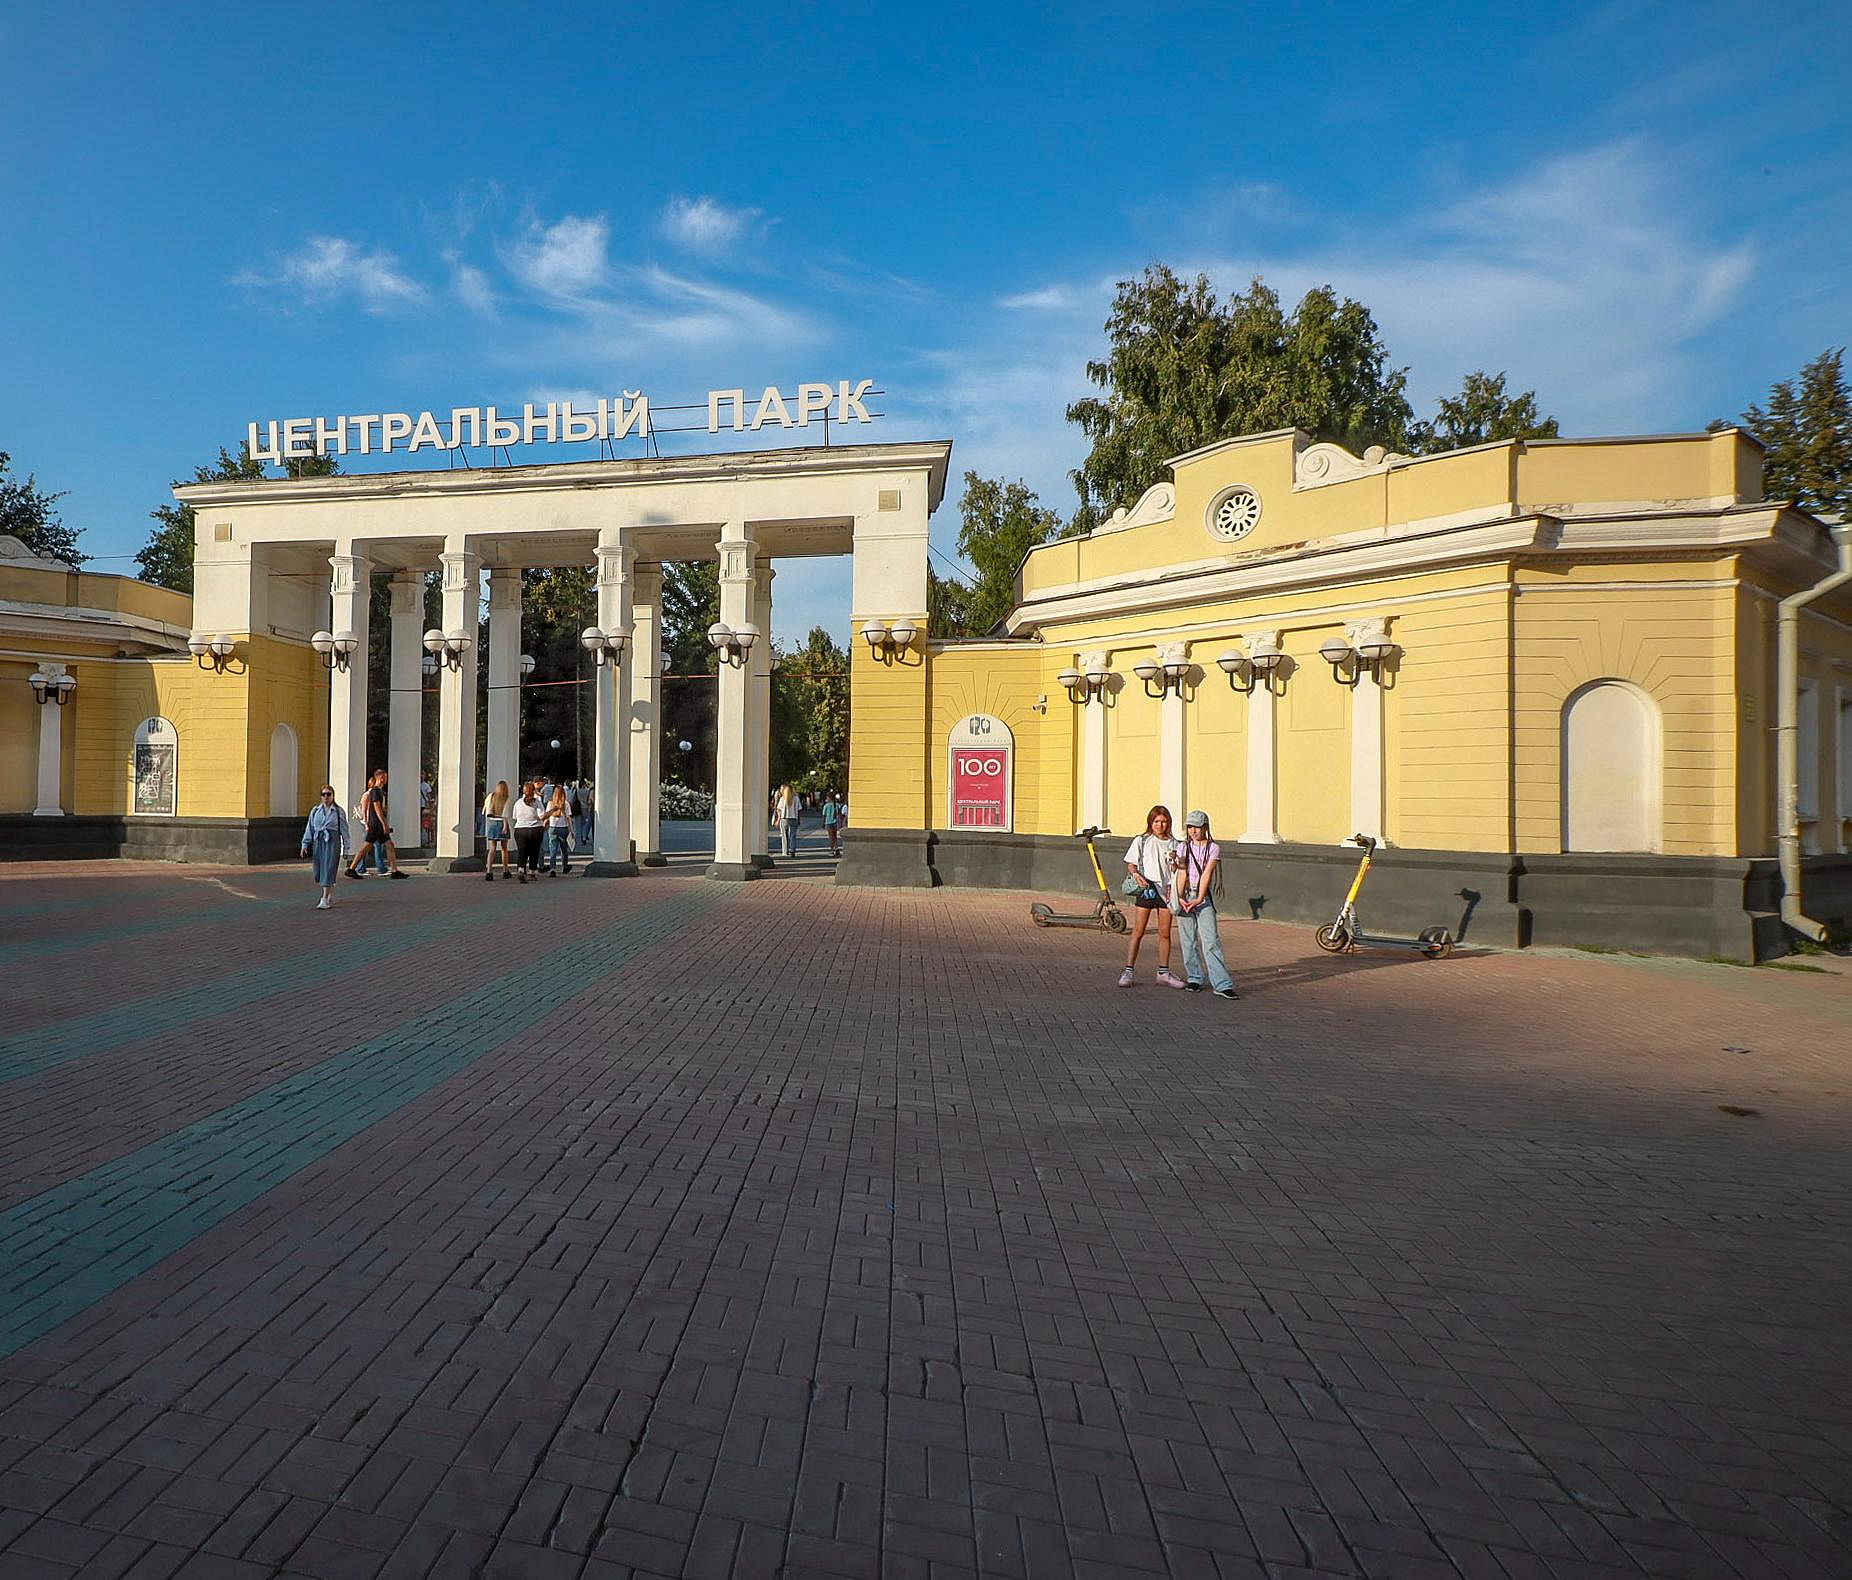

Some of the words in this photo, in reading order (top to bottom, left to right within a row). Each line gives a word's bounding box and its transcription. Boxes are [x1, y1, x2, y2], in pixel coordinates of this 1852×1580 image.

[248, 389, 650, 466] ЦЕНТРАЛЬНЫЙ
[708, 379, 873, 433] ПАРК
[958, 758, 1001, 776] 100
